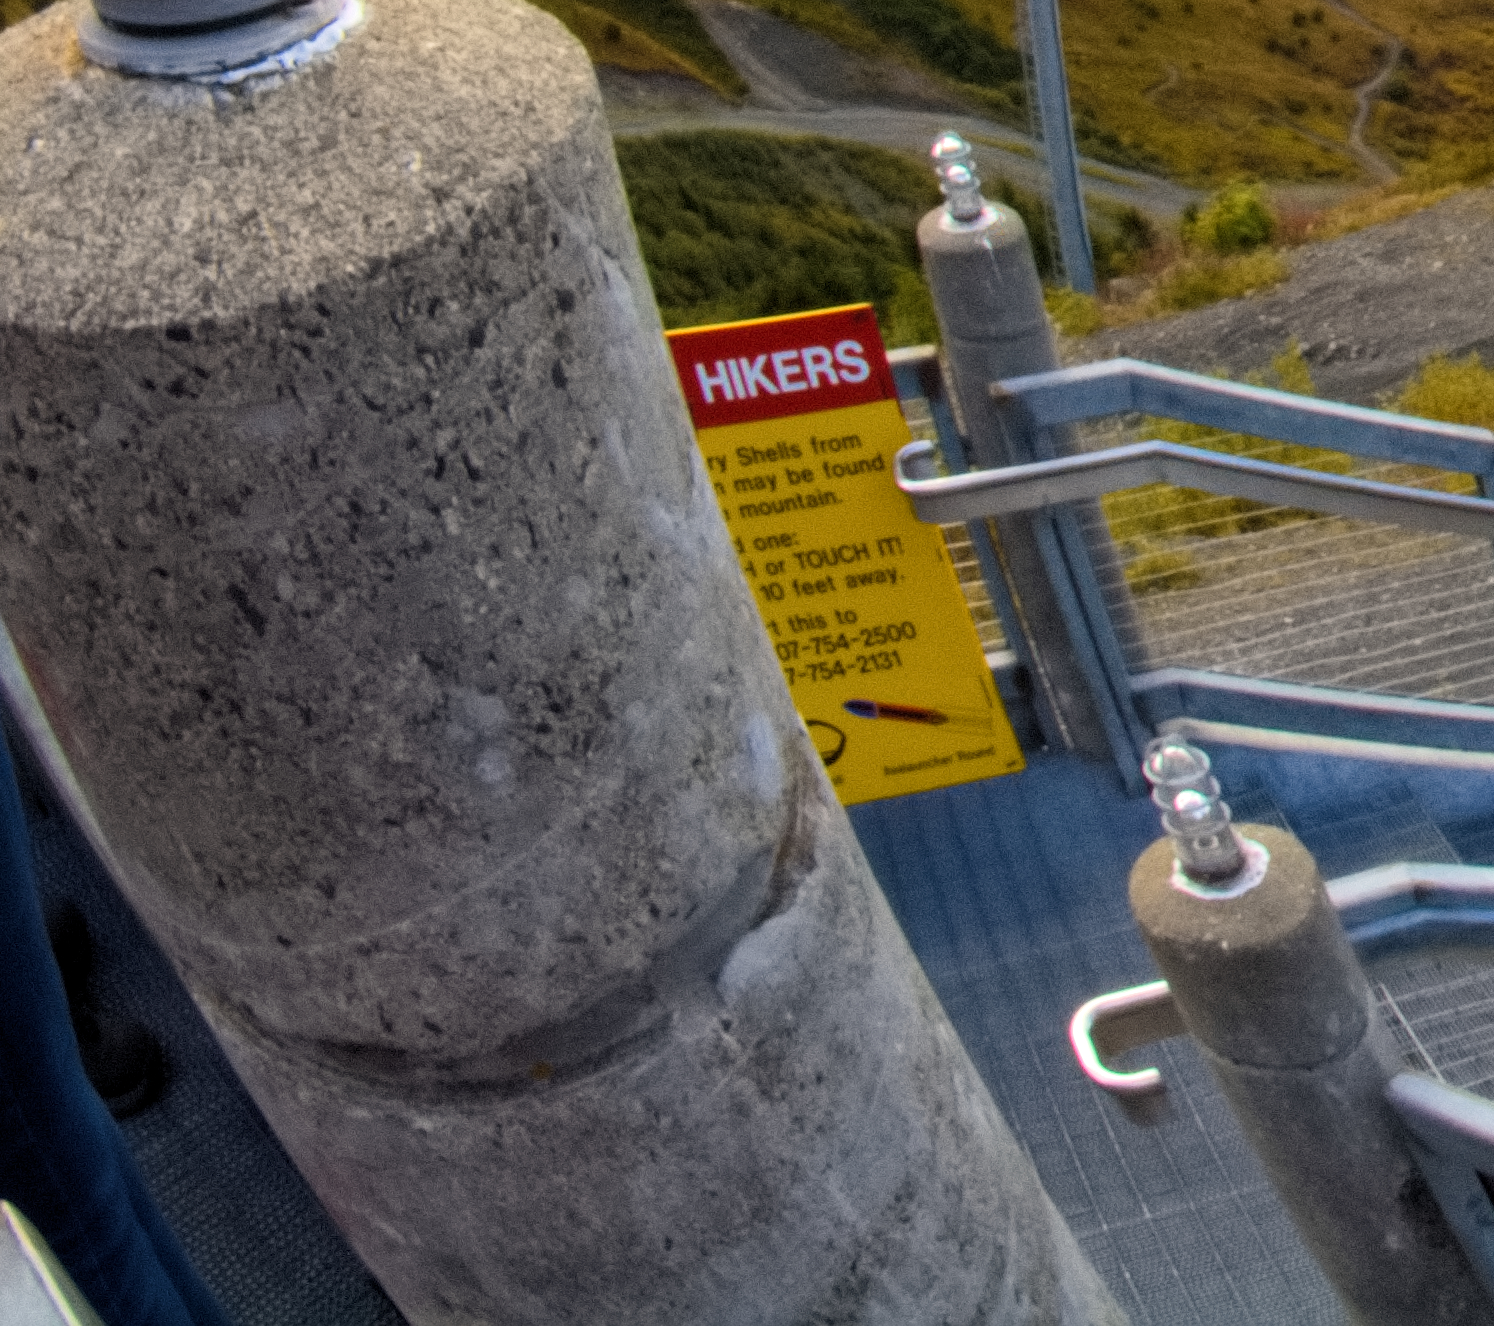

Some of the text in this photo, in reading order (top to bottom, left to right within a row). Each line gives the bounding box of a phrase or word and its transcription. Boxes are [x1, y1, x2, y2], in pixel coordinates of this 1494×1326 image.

[694, 339, 871, 404] HIKERS
[736, 441, 802, 467] Shells
[810, 433, 862, 455] from
[733, 473, 777, 492] may
[785, 466, 814, 486] be
[823, 454, 886, 479] found
[738, 489, 843, 518] mountain.
[753, 532, 800, 552] one:
[765, 560, 786, 577] or
[793, 542, 871, 570] TOUCH
[760, 566, 906, 601] 10 feet away.
[788, 614, 828, 634] this
[834, 609, 858, 625] to
[775, 621, 917, 662] 07-754-2500
[785, 649, 903, 686] 7-754-2131
